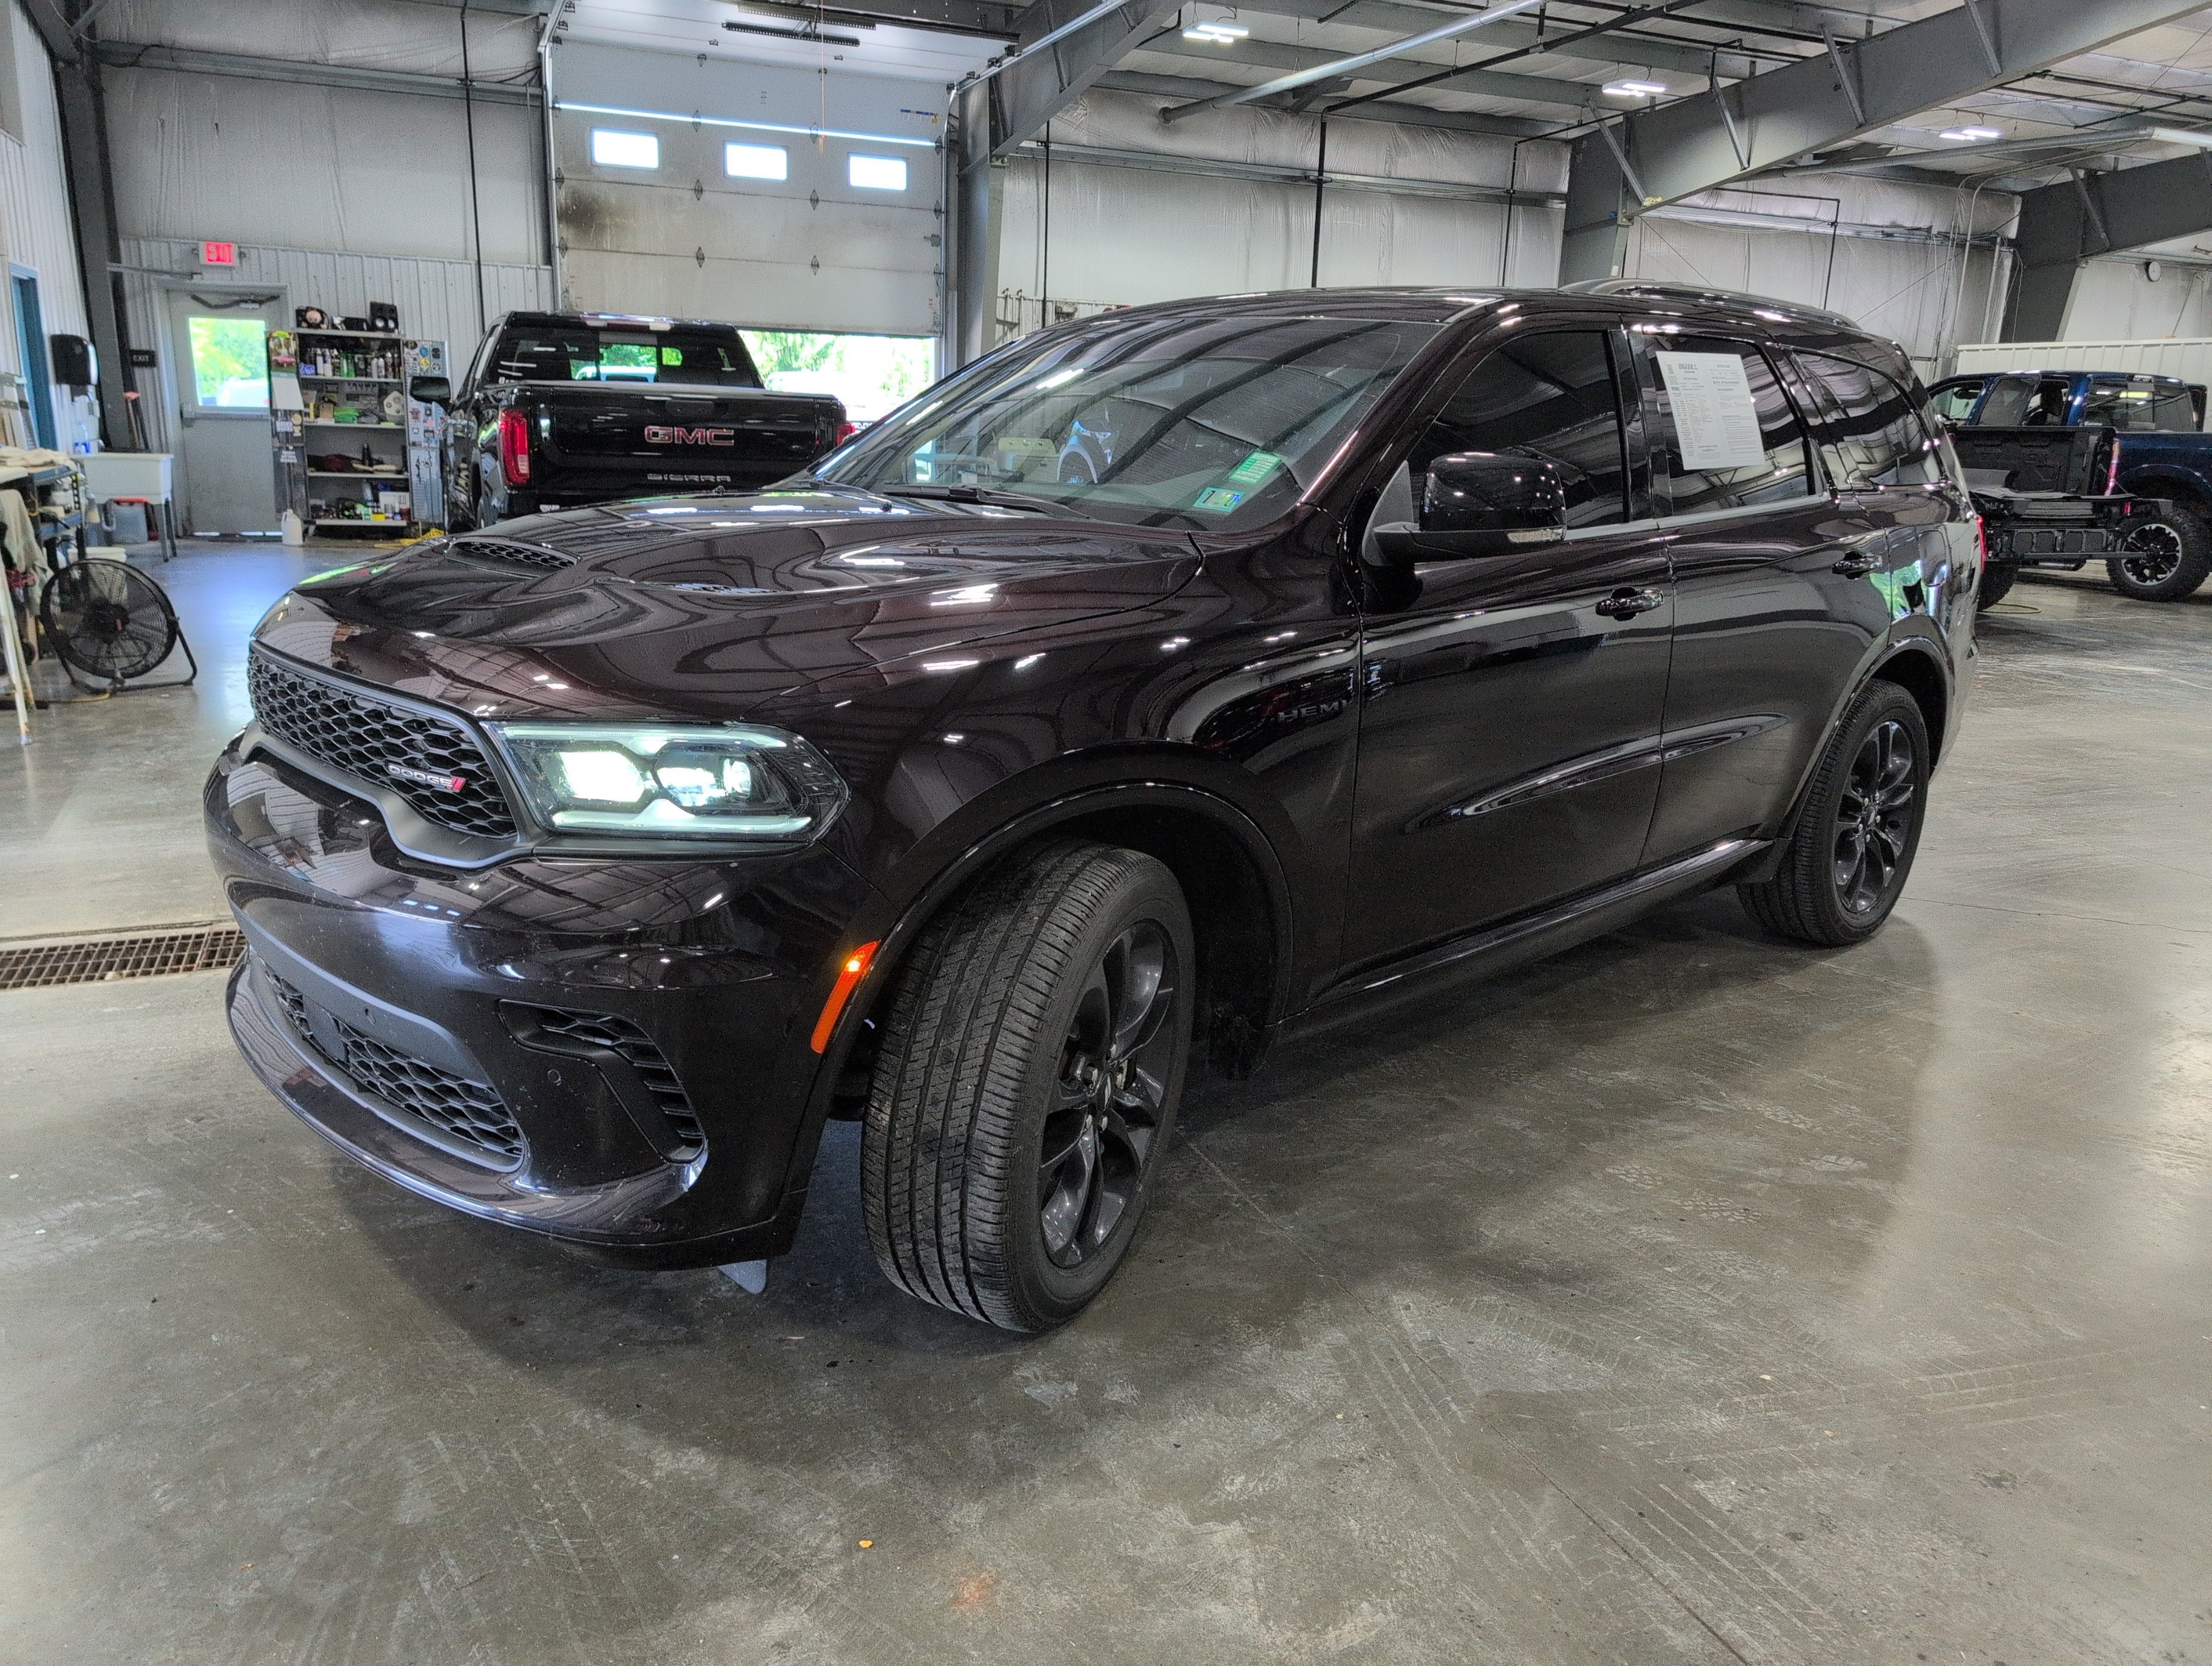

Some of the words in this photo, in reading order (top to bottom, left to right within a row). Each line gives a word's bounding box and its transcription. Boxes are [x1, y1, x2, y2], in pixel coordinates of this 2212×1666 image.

[206, 242, 233, 264] EXIT
[132, 354, 149, 362] EXIT
[645, 425, 734, 446] GMC
[1277, 699, 1348, 723] HEMI
[388, 765, 453, 788] DODGE
